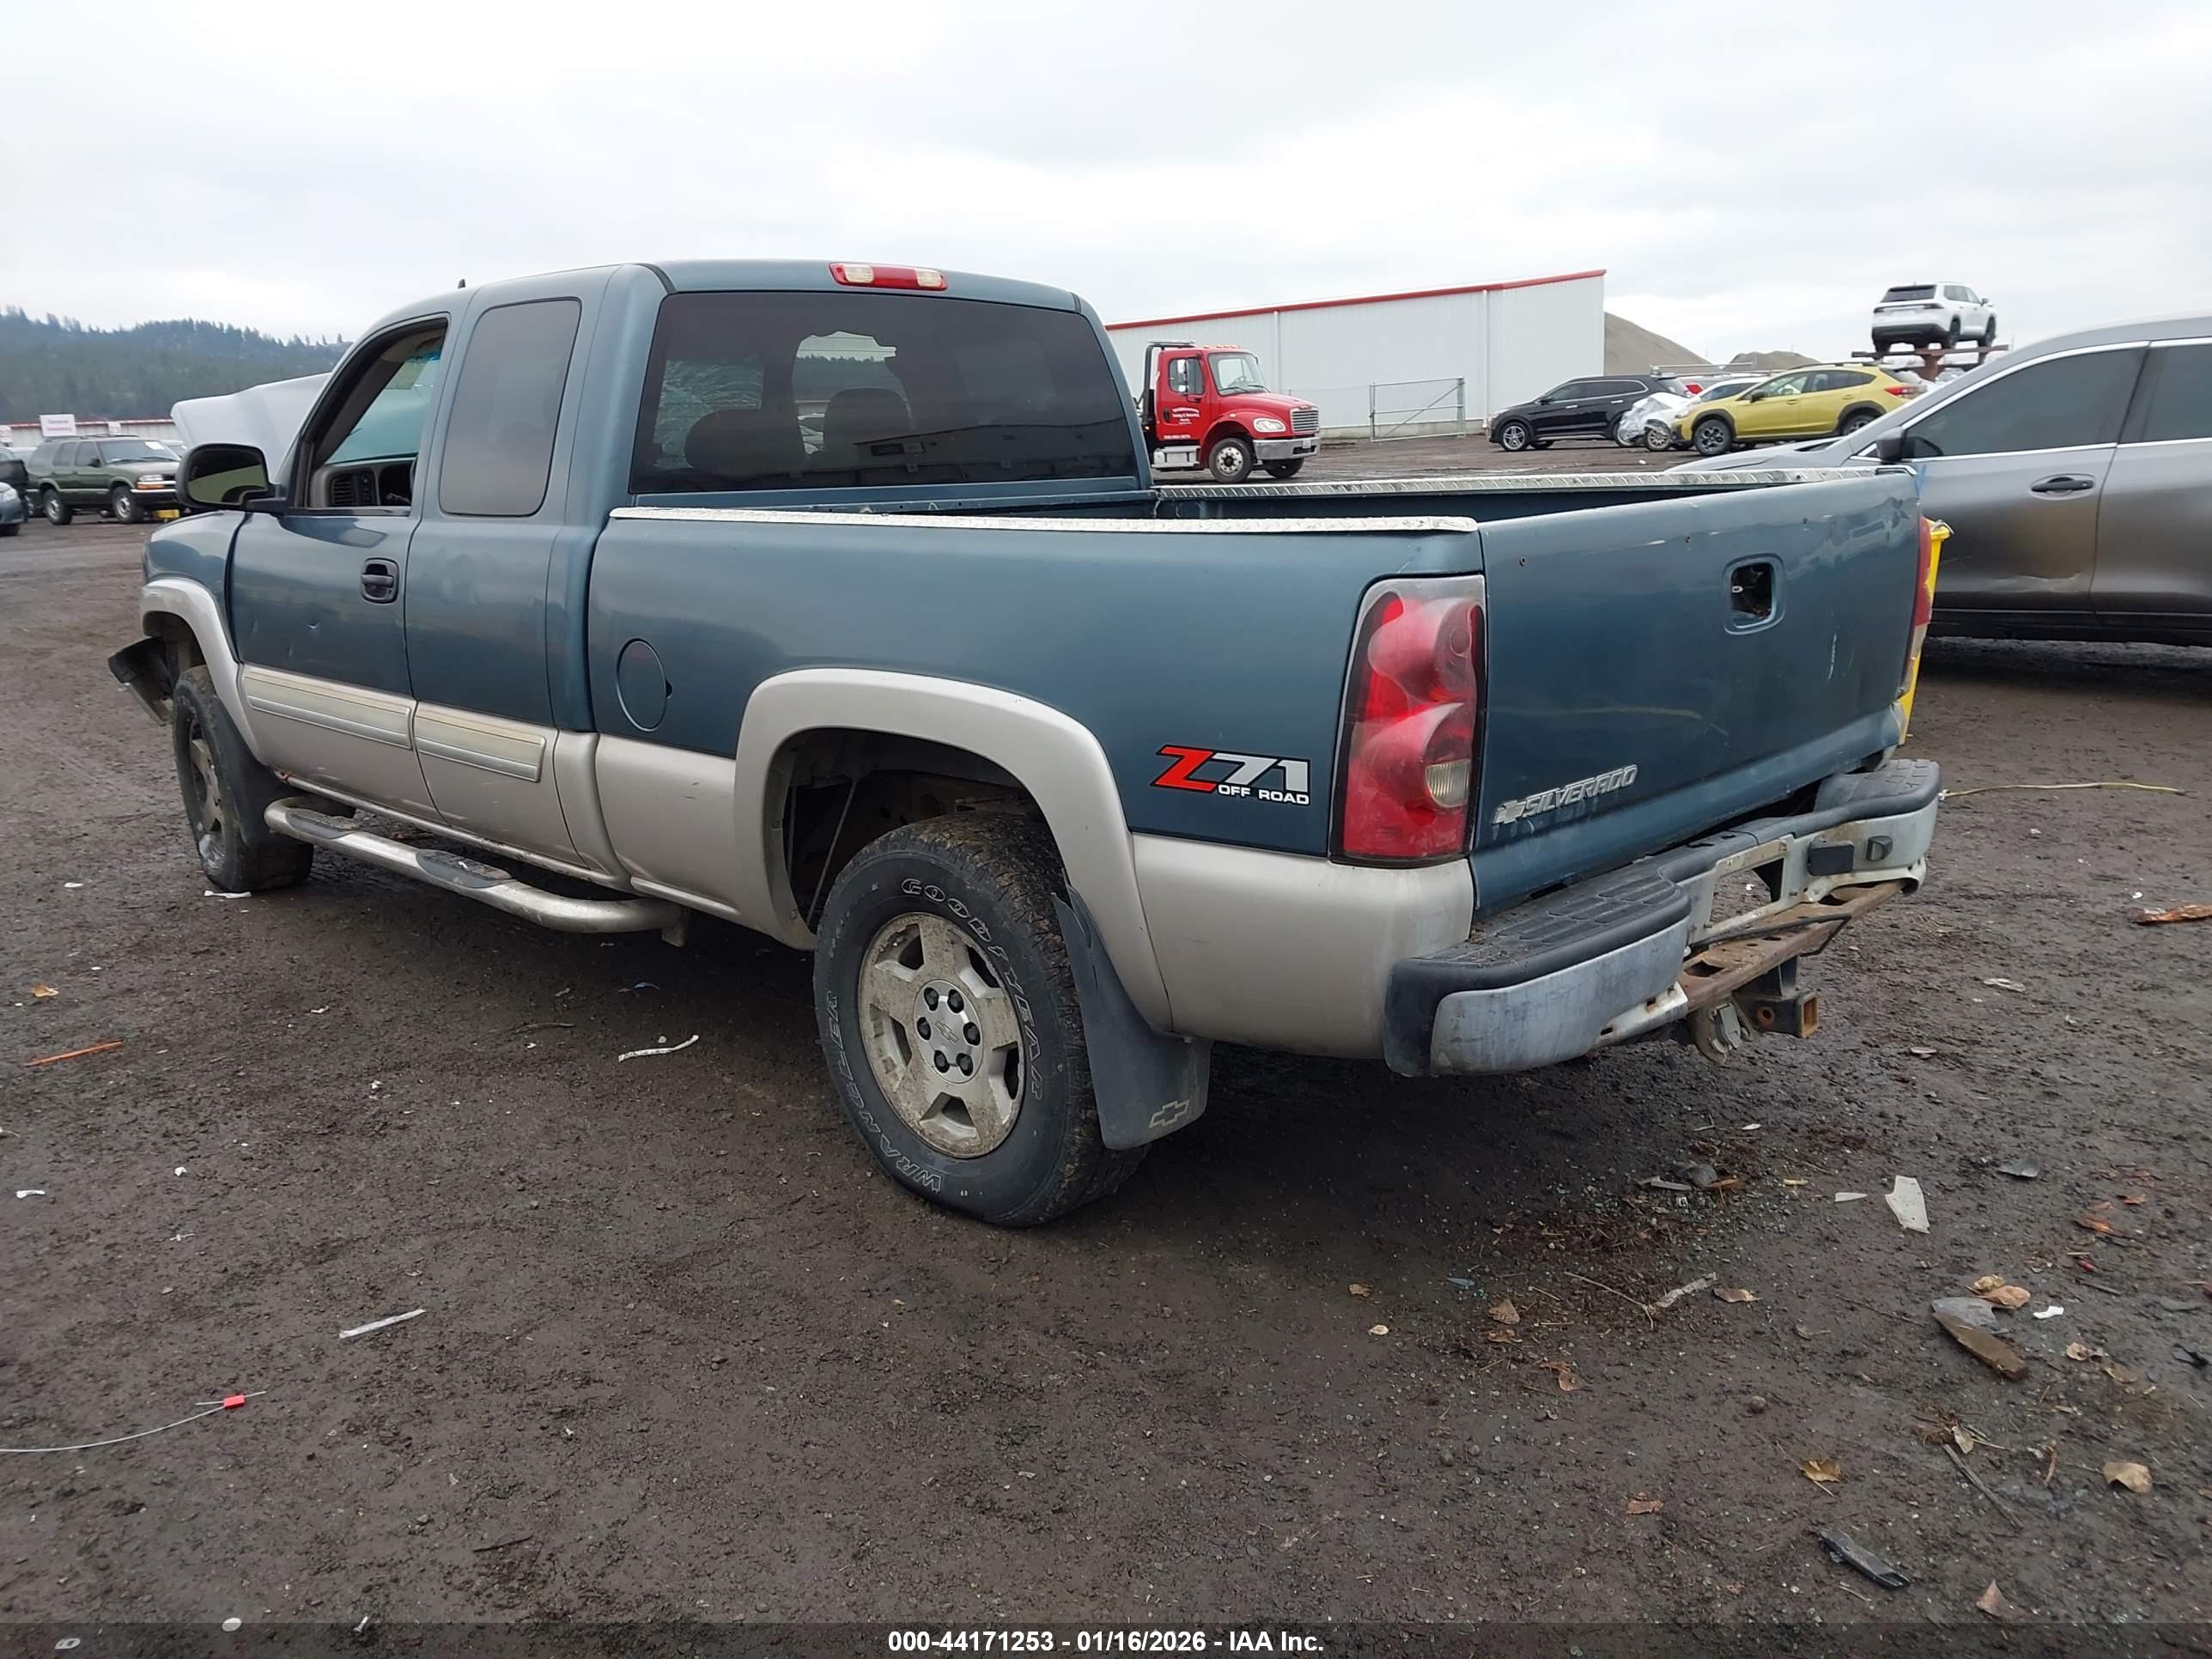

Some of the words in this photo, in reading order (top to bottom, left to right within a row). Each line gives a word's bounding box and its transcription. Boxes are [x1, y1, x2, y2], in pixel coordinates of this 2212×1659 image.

[1152, 745, 1310, 793] Z71
[1218, 784, 1251, 798] OFF
[1258, 788, 1310, 805] ROAD
[1522, 763, 1638, 817] SILVERADO
[901, 878, 1044, 1101] GOODYEAR
[825, 989, 943, 1194] WRANGLER
